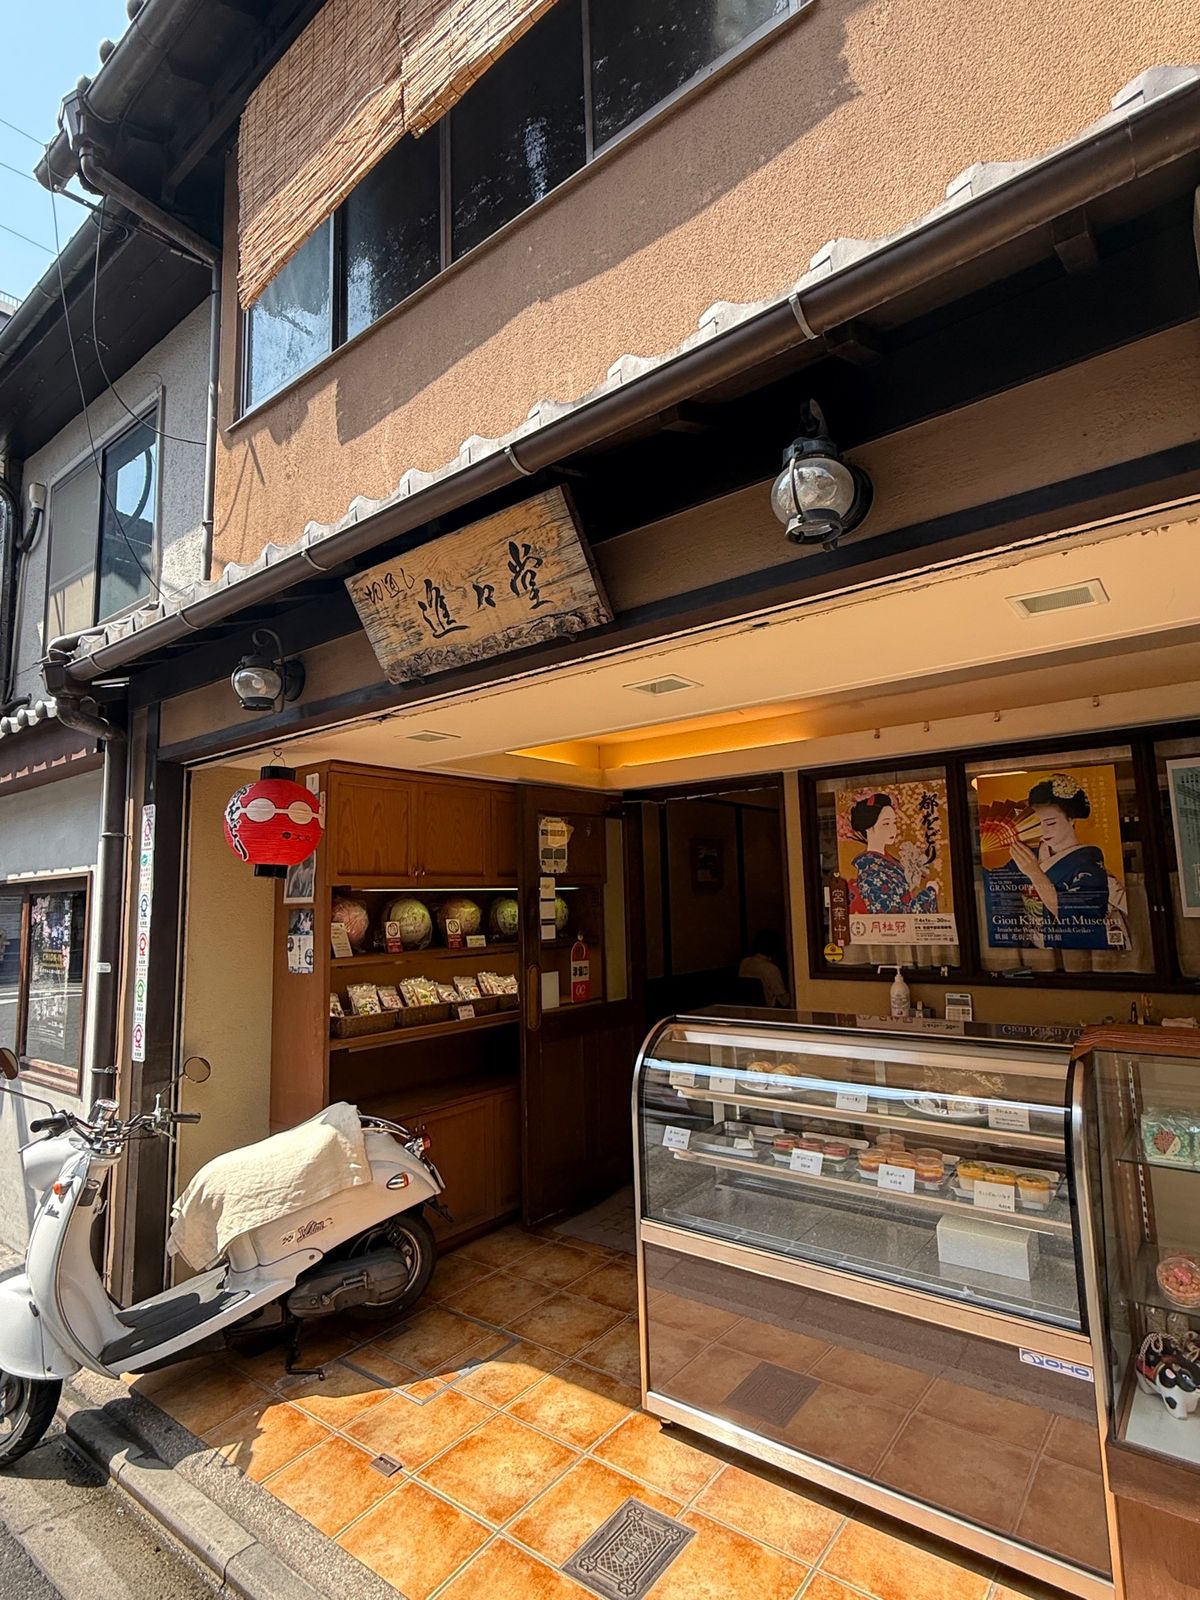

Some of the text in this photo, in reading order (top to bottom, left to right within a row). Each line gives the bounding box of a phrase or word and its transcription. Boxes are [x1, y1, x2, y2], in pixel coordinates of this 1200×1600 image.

[364, 567, 415, 605] 切通し
[416, 540, 555, 640] 進々堂
[918, 791, 940, 866] 都をどり
[989, 884, 1018, 892] GRAND
[831, 888, 847, 939] 営業中
[870, 920, 906, 934] 月桂冠
[992, 915, 1018, 926] Gion
[1051, 915, 1071, 926] Art
[1072, 915, 1122, 926] Museum
